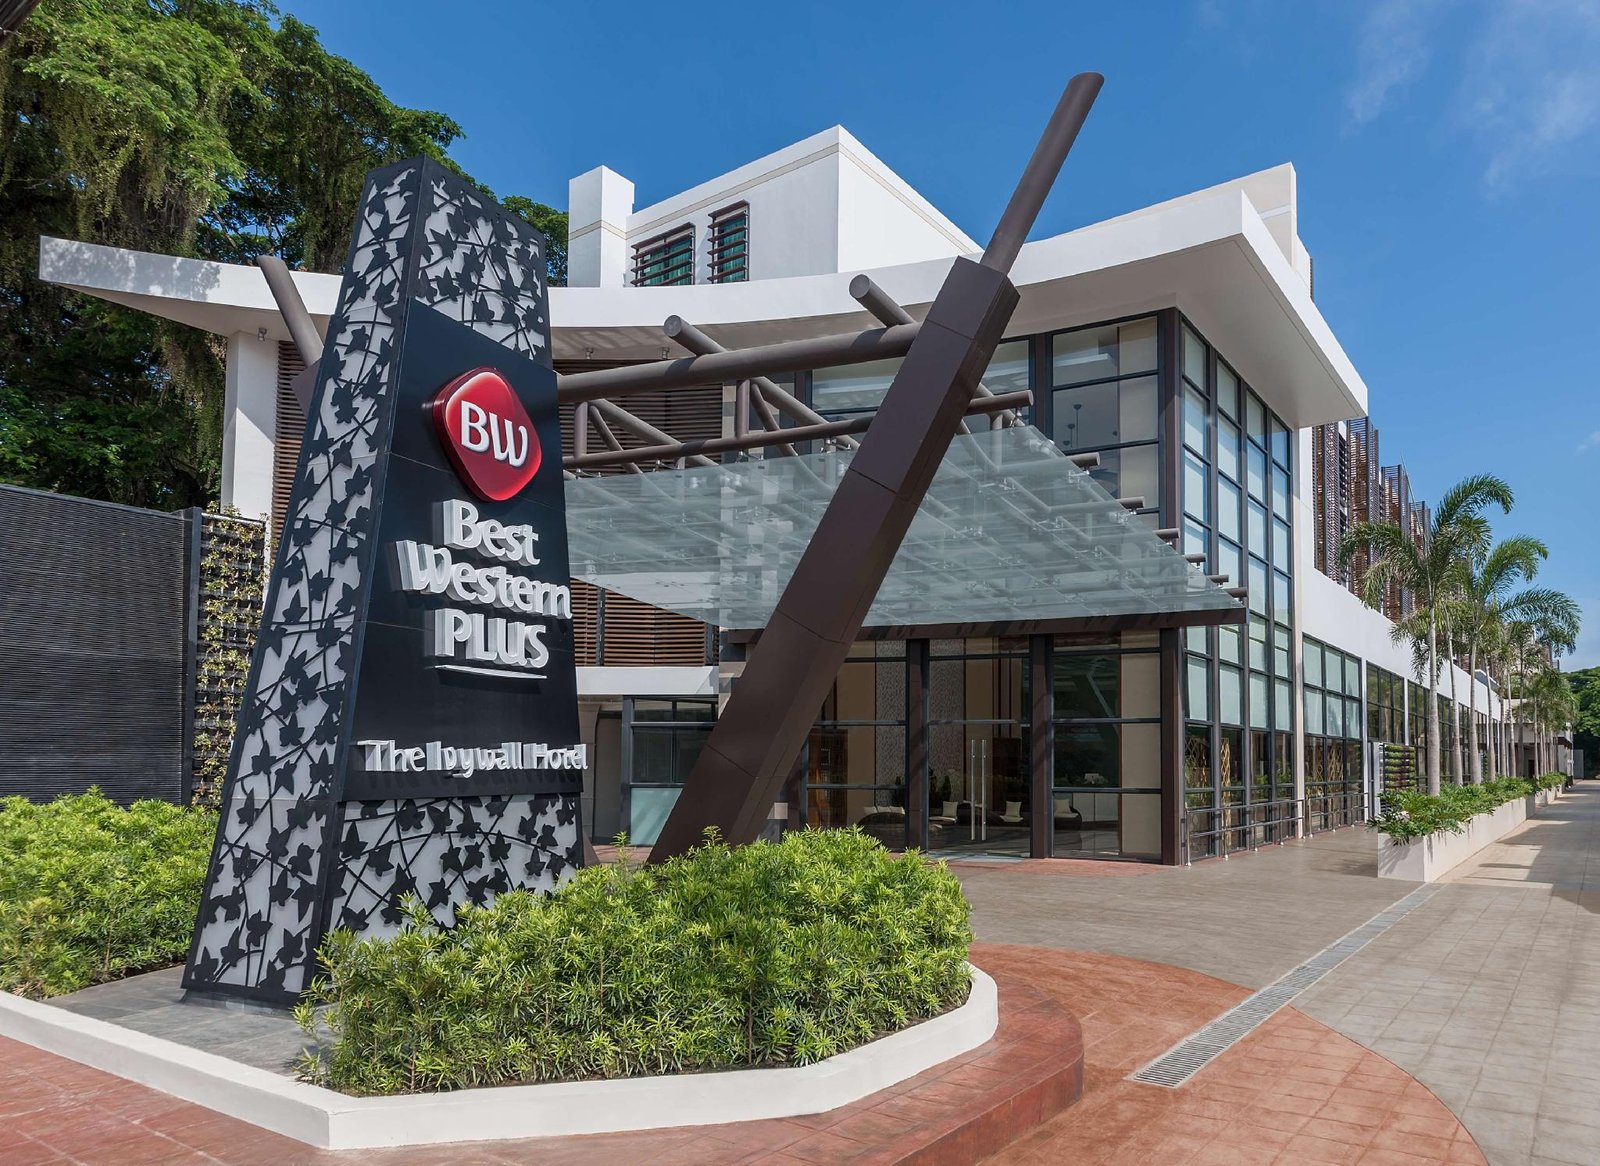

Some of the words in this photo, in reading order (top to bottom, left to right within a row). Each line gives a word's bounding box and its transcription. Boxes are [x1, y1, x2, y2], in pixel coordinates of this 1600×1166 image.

[460, 400, 528, 467] BW
[442, 499, 541, 566] Best
[396, 541, 572, 619] Western
[357, 740, 425, 773] The
[524, 743, 588, 770] Hotel
